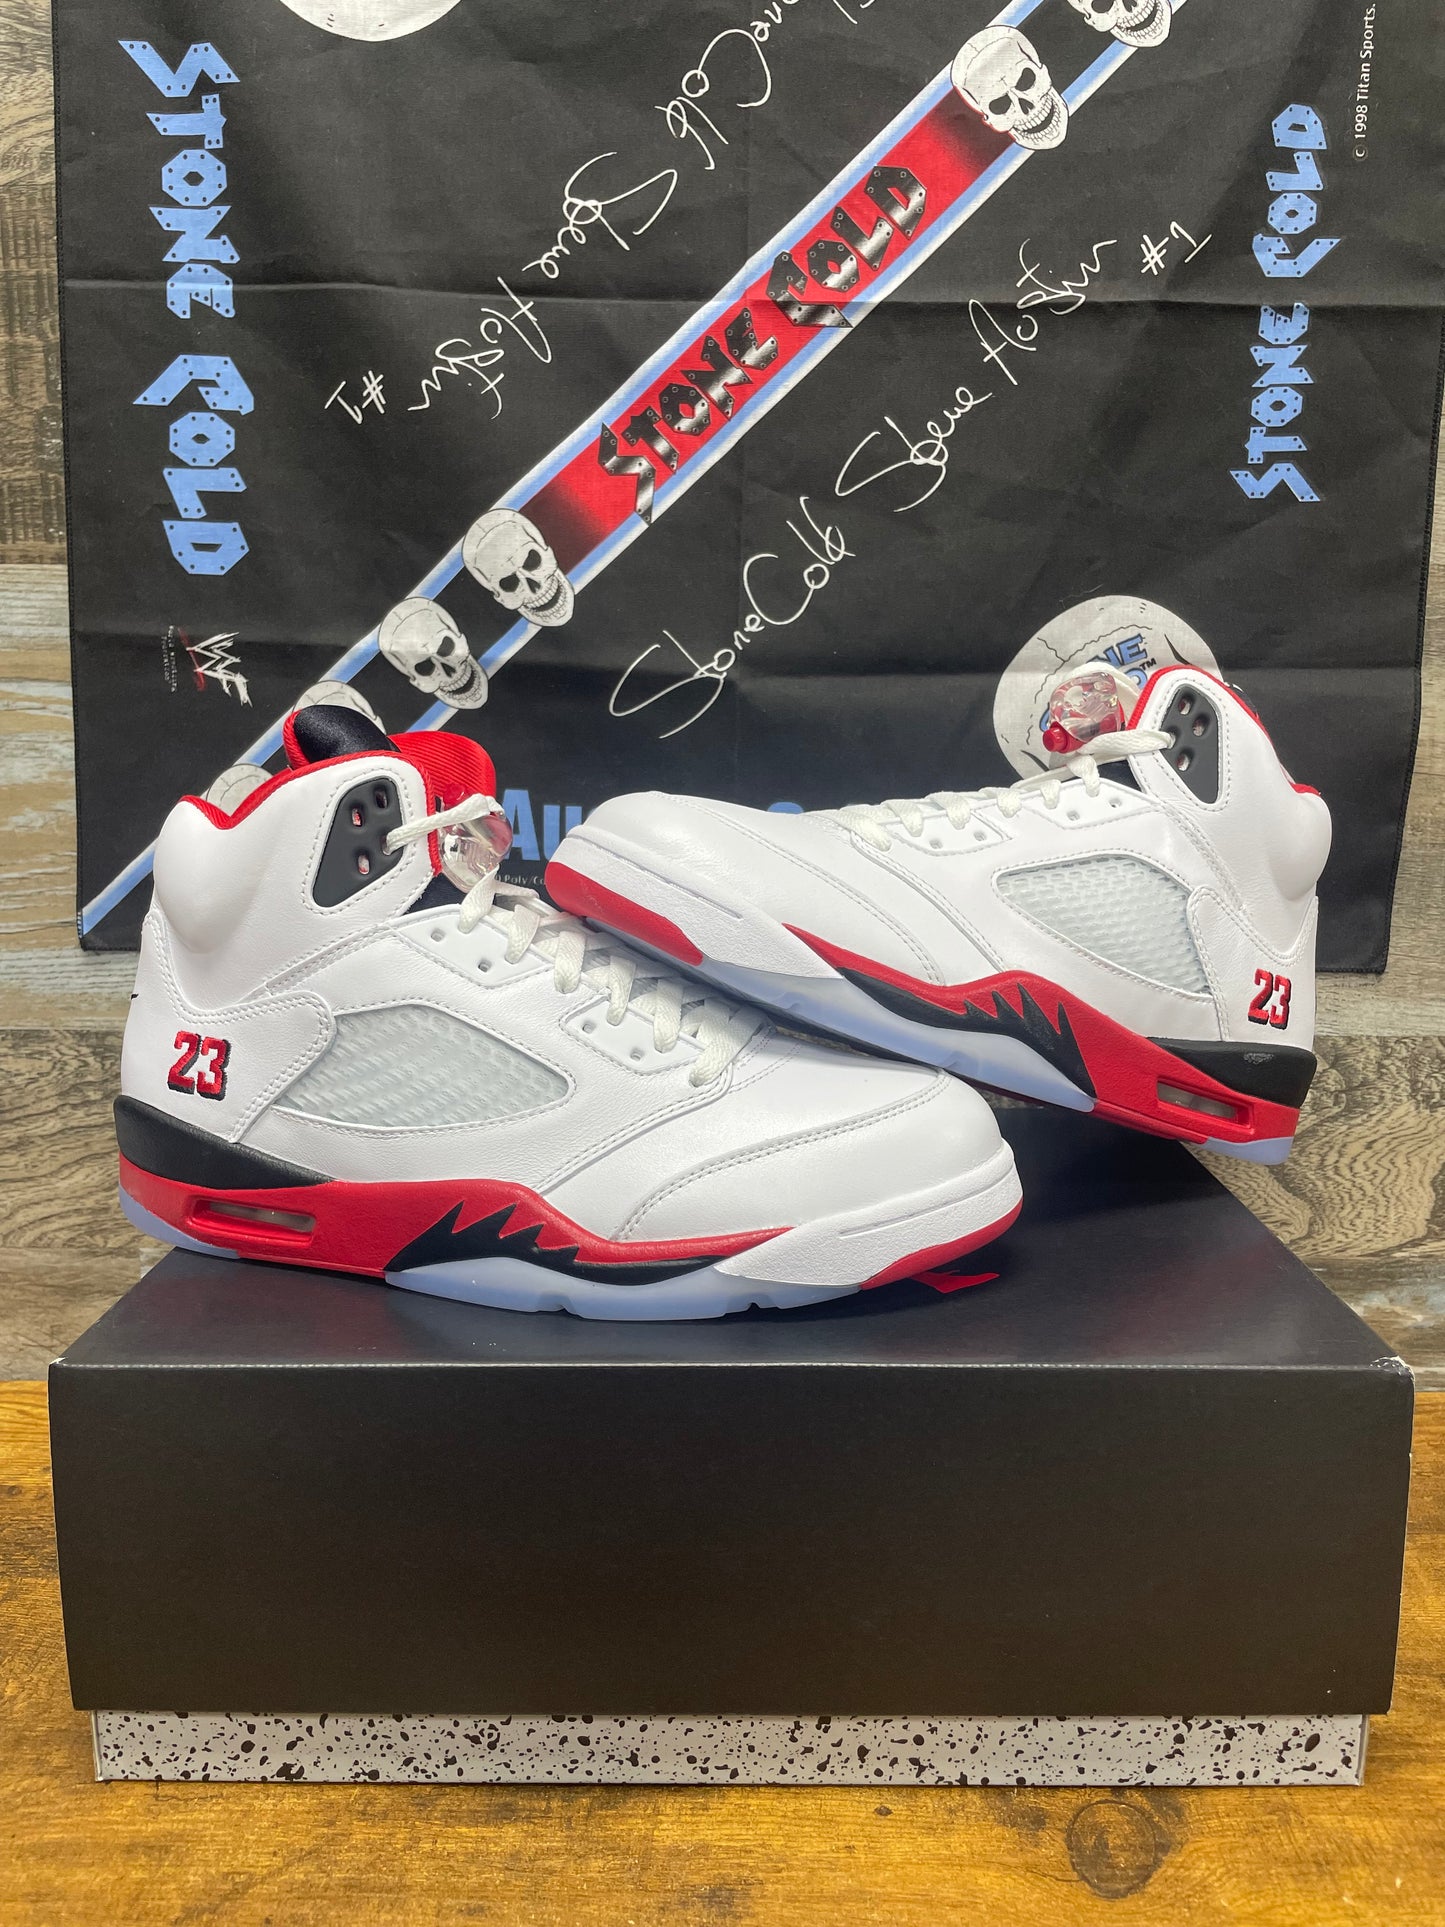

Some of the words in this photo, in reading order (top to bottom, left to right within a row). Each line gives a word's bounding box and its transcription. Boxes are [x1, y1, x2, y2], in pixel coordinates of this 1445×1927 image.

[1359, 3, 1376, 59] Sports.
[1356, 62, 1371, 102] Titan
[1354, 104, 1368, 139] 1998
[118, 40, 241, 319] STONE
[1252, 103, 1342, 279] COLD
[1140, 221, 1213, 276] #1
[597, 307, 780, 528] STONE
[765, 165, 927, 328] COLD
[324, 370, 387, 425] #1
[1230, 302, 1321, 503] STONE
[133, 355, 255, 576] COLD
[500, 789, 583, 861] Au
[1247, 968, 1292, 1031] 23
[167, 1030, 232, 1101] 23
